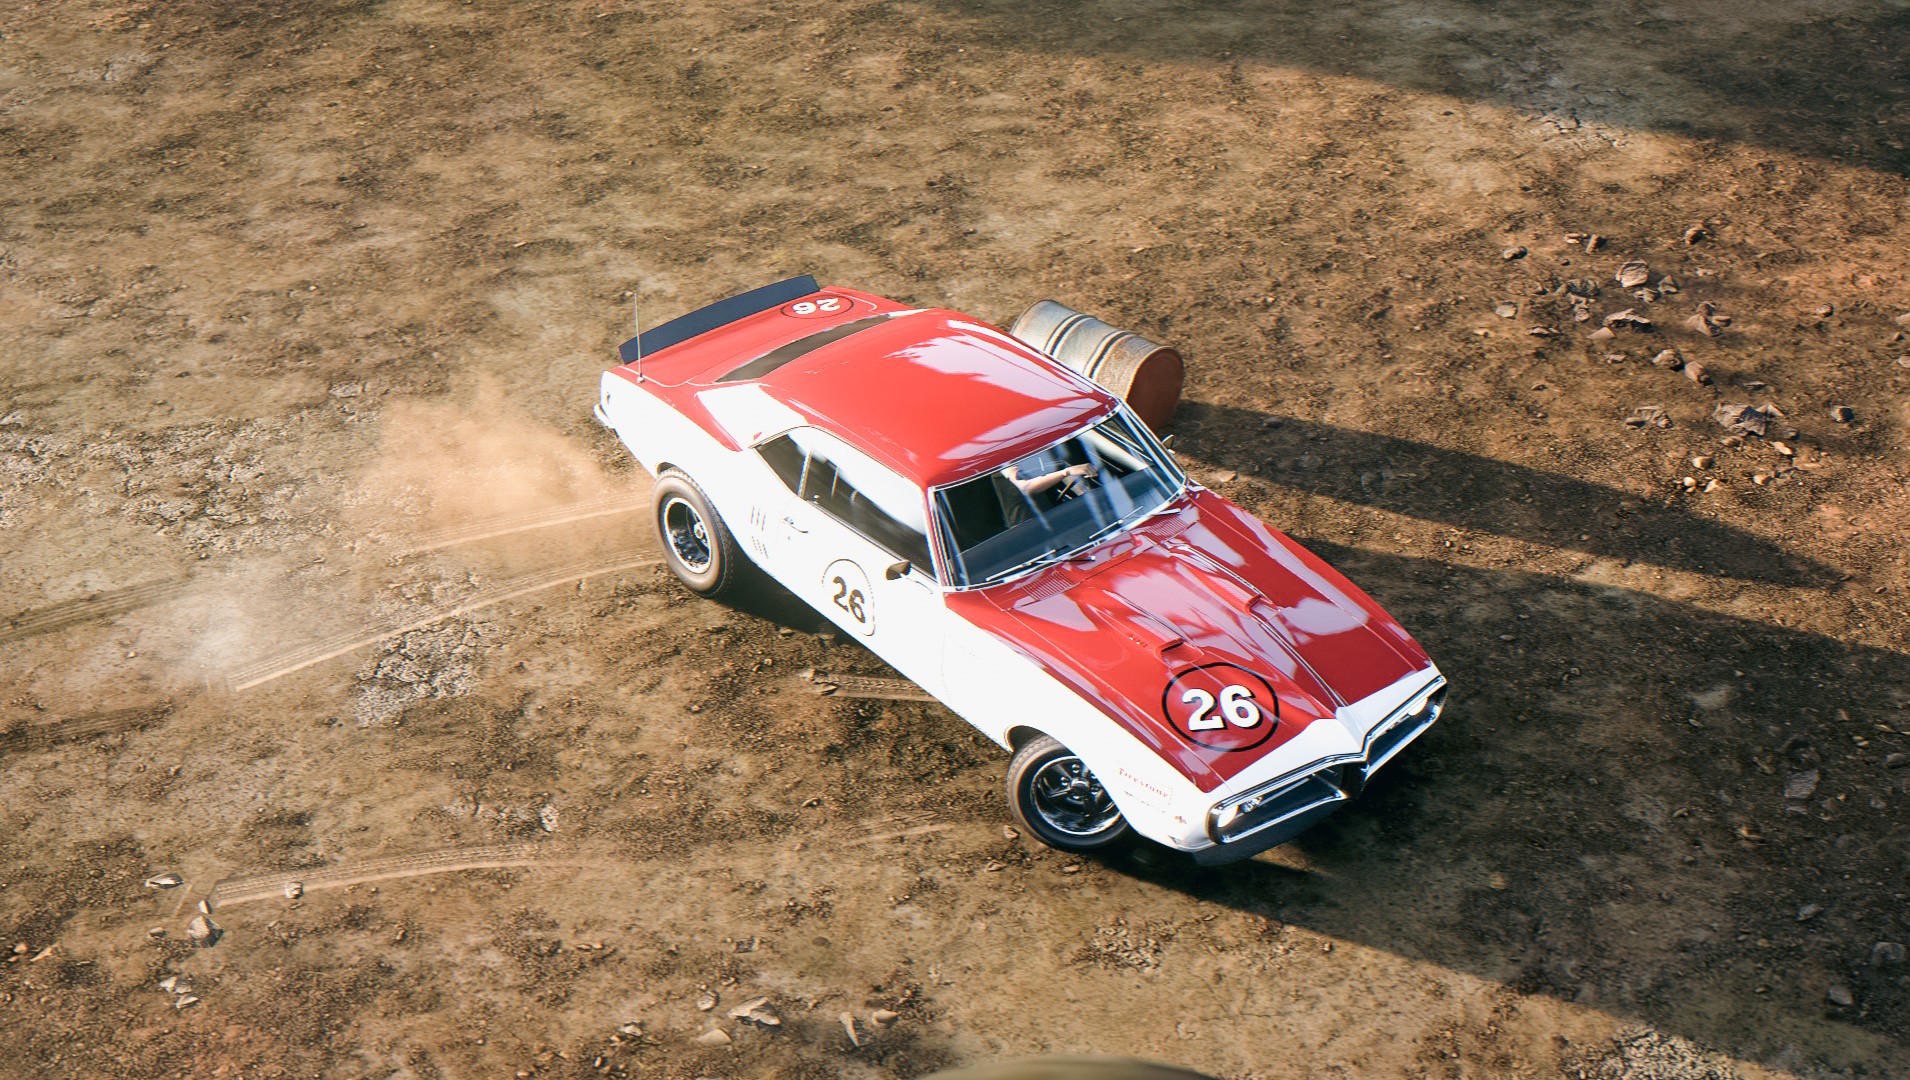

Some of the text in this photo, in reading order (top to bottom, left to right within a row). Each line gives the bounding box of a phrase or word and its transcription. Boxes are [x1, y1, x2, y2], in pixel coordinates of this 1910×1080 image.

[792, 298, 840, 315] 26
[832, 576, 866, 623] 26
[1182, 685, 1262, 732] 26
